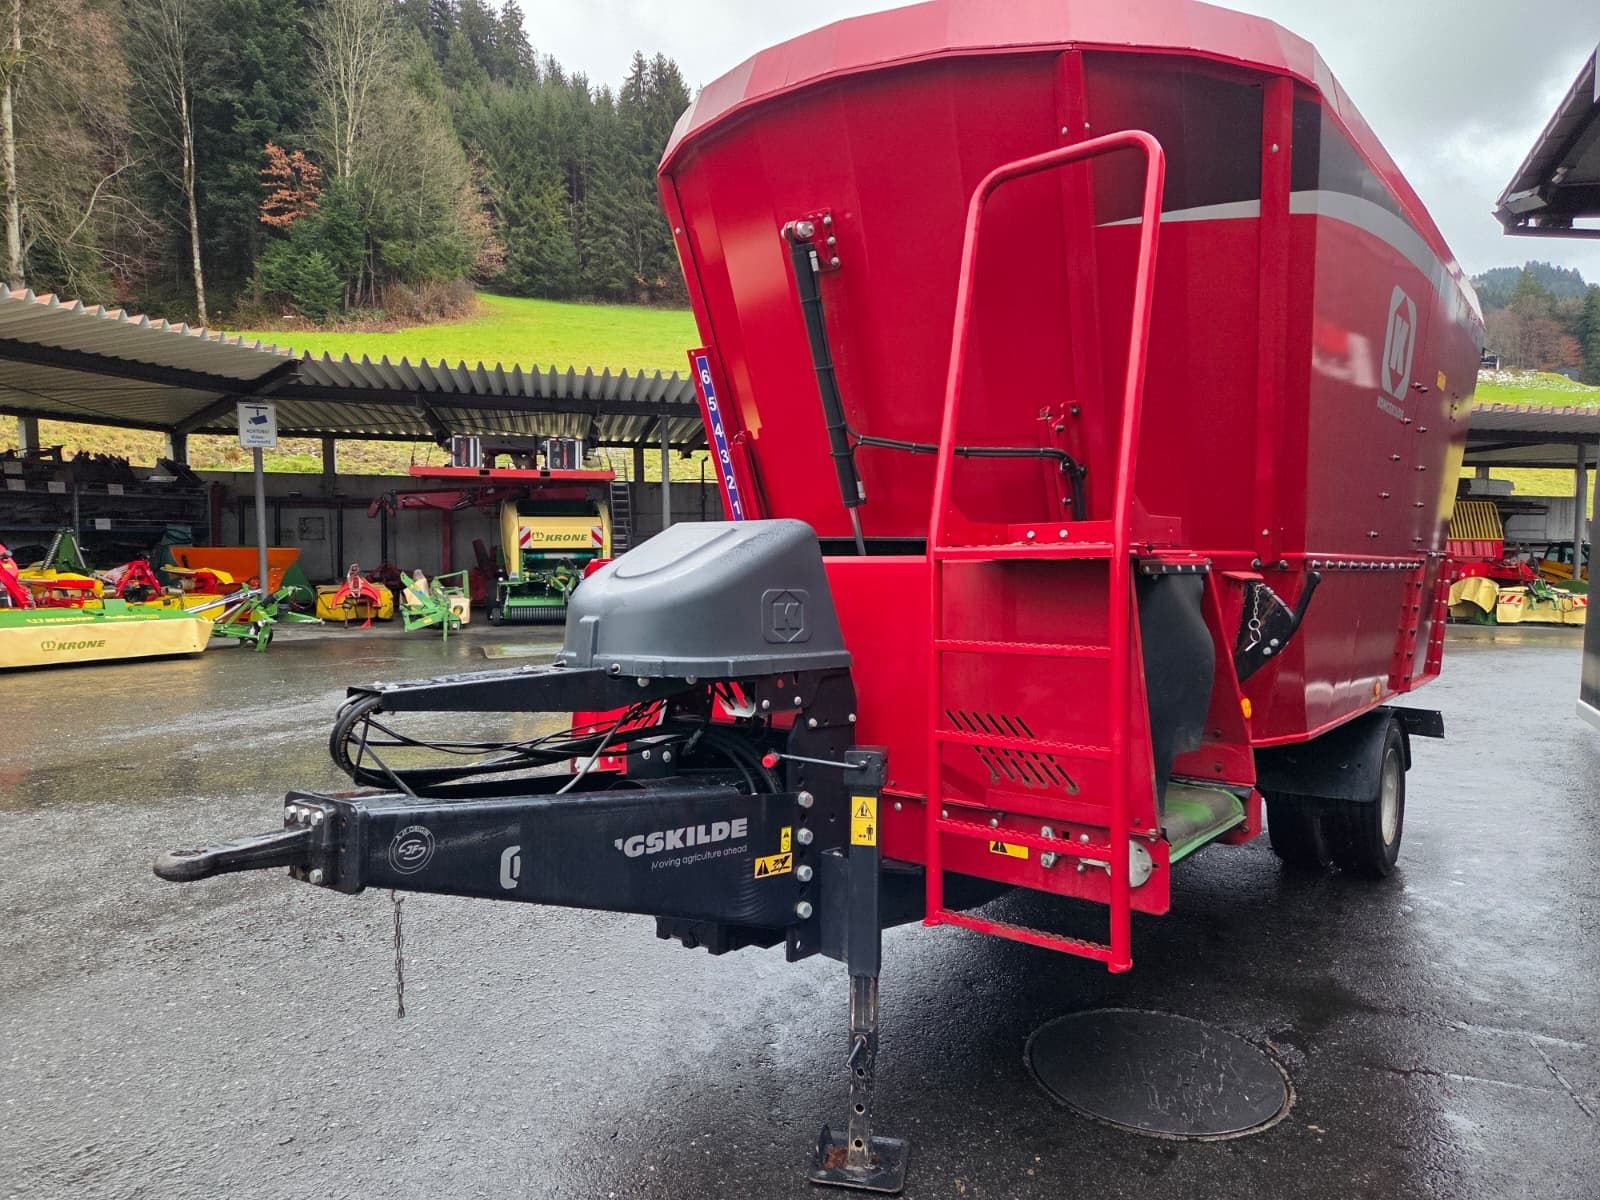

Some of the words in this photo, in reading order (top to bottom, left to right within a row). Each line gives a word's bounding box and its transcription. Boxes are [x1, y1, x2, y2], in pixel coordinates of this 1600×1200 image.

[701, 369, 711, 385] 6
[708, 397, 717, 411] 5
[715, 423, 723, 437] 4
[721, 450, 729, 463] 3
[726, 476, 736, 490] 2
[733, 501, 741, 515] 1
[545, 533, 588, 542] KRONE
[57, 640, 107, 651] KRONE
[614, 817, 748, 858] GSKILDE
[651, 857, 681, 872] Moving
[682, 849, 722, 865] agriculture
[723, 844, 748, 857] ahead
